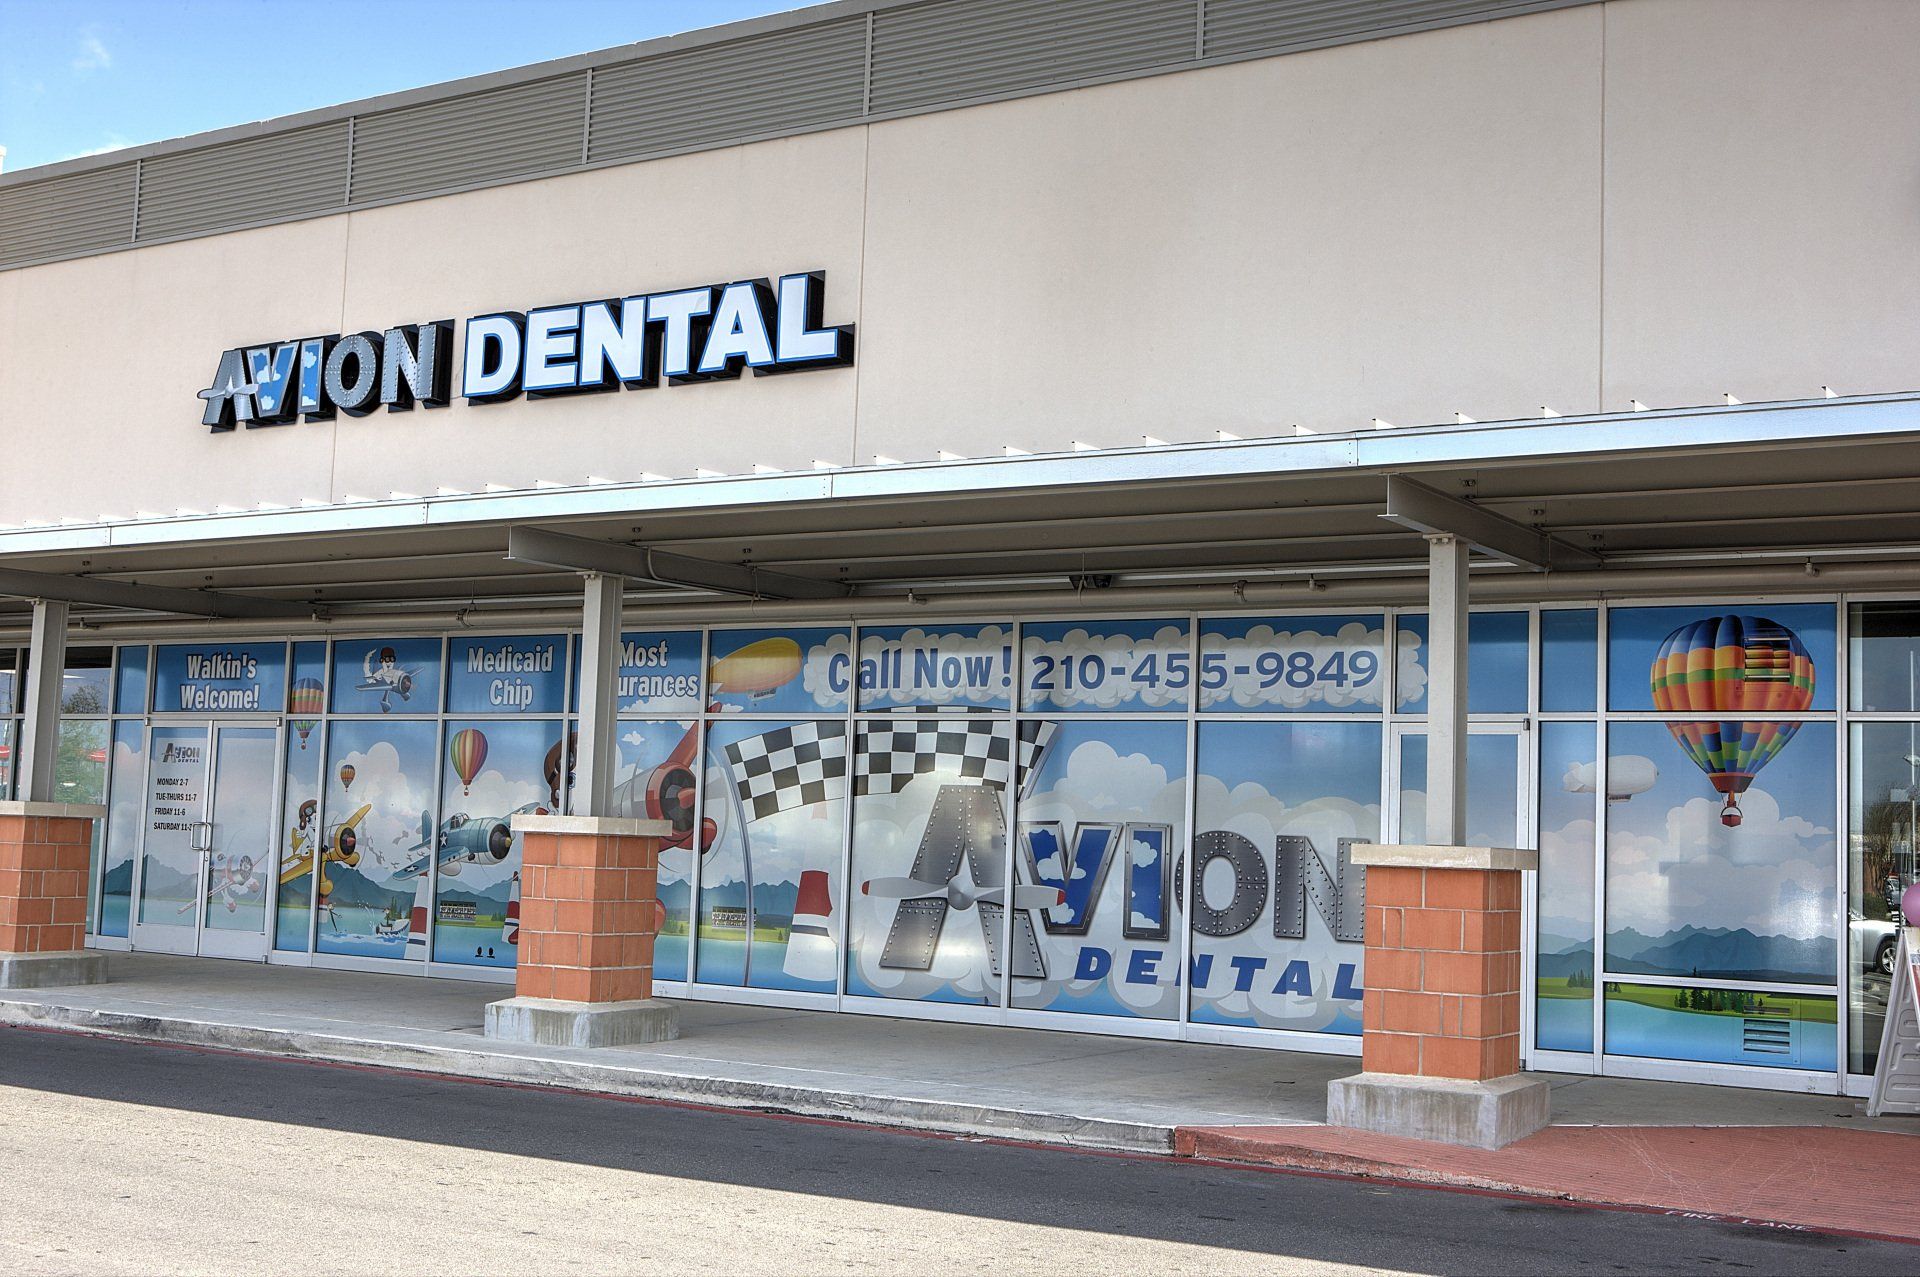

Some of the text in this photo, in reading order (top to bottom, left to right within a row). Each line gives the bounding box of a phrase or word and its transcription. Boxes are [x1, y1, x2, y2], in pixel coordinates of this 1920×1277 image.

[198, 272, 842, 431] AVION DENTAL
[187, 653, 257, 680] Walkin's
[467, 645, 554, 673] Medicaid
[619, 641, 668, 668] Most
[828, 645, 1380, 694] Call Now! 210-455-9849
[180, 683, 260, 710] Welcome!
[489, 679, 533, 711] Chip
[618, 675, 699, 697] urances
[157, 777, 189, 786] MONDAY 2-7
[156, 792, 197, 801] TUE-THURS 11-7
[154, 807, 186, 816] FRIDAY 11-6
[153, 822, 180, 831] SATURDAY
[879, 784, 1365, 979] AVION
[1074, 947, 1364, 999] DENTAL
